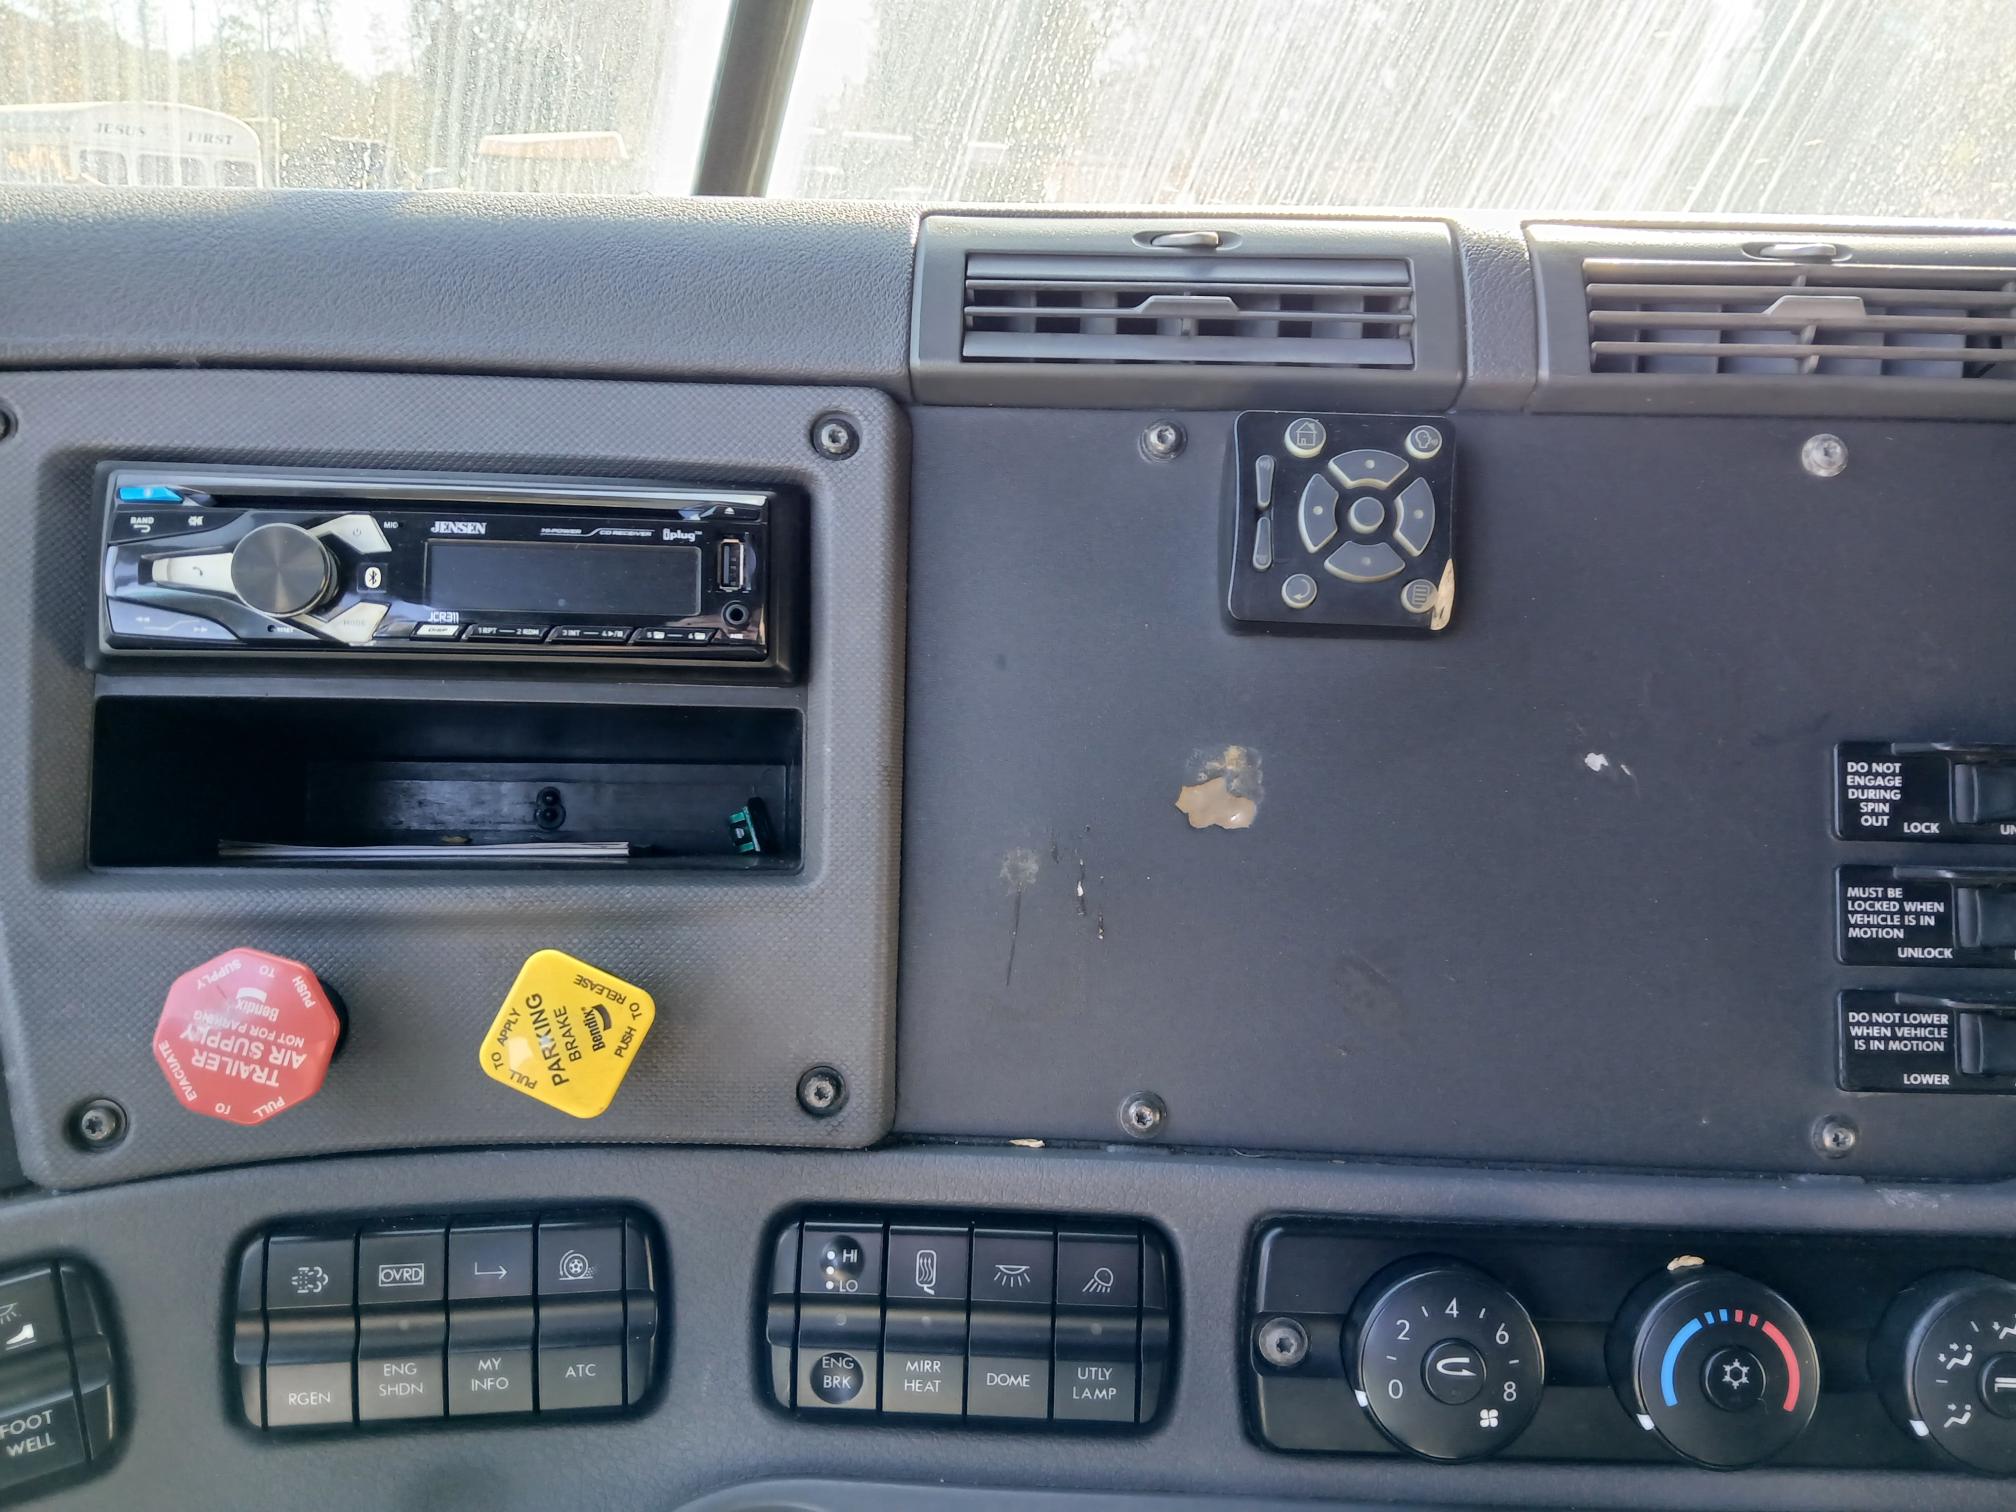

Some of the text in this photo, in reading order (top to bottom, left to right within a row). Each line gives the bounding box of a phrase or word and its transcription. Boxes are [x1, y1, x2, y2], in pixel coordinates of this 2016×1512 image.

[97, 122, 234, 146] JESUS FIRST
[130, 516, 154, 525] BAND
[430, 521, 487, 535] JENSEN
[428, 611, 460, 624] JCR311
[1847, 762, 1902, 774] DO NOT
[1846, 775, 1902, 787] ENGAGE
[1848, 789, 1901, 800] DURING
[1860, 802, 1889, 813] SPIN
[1860, 815, 1890, 826] OUT
[1903, 822, 1940, 834] LOCK
[1847, 887, 1903, 898] MUST BE
[1847, 901, 1945, 913] LOCKED WHEN
[1848, 914, 1935, 926] VEHICLE IS IN
[1848, 927, 1905, 939] MOTION
[1897, 947, 1953, 959] UNLOCK
[196, 959, 316, 1008] PUSH TO SUPPLY
[236, 998, 280, 1022] Bendix
[573, 974, 643, 1058] PUSH TO RELEASE
[1848, 1012, 1949, 1024] DO NOT LOWER
[193, 1010, 304, 1048] NOT FOR PARKING
[553, 1005, 582, 1063] BRAKE
[1850, 1026, 1948, 1038] WHEN VEHICLE
[180, 1023, 307, 1069] AIR SUPPLY
[525, 992, 570, 1087] PARKING
[1854, 1039, 1945, 1052] IS IN MOTION
[491, 1007, 538, 1090] PULL TO APPLY
[191, 1048, 280, 1087] TRAILER
[158, 1039, 286, 1118] PULL TO EVACUATE
[1903, 1073, 1949, 1085] LOWER
[842, 1248, 858, 1264] HI
[381, 1268, 423, 1283] OVRD
[839, 1279, 859, 1293] LO
[1444, 1297, 1459, 1318] 4
[1396, 1319, 1410, 1341] 2
[1495, 1323, 1509, 1345] 6
[383, 1362, 418, 1377] ENG
[477, 1357, 501, 1371] MY
[821, 1355, 855, 1370] ENG
[905, 1359, 942, 1374] MIRR
[564, 1363, 597, 1378] ATC
[1077, 1366, 1113, 1381] UTLY
[471, 1376, 509, 1392] INFO
[823, 1375, 851, 1390] BRK
[904, 1378, 942, 1393] HEAT
[986, 1372, 1031, 1387] DOME
[379, 1381, 424, 1397] SHDN
[1072, 1385, 1117, 1400] LAMP
[1388, 1379, 1403, 1399] 0
[1503, 1381, 1517, 1402] 8
[288, 1391, 331, 1407] RGEN
[0, 1409, 53, 1439] FOOT
[6, 1432, 56, 1457] WELL
